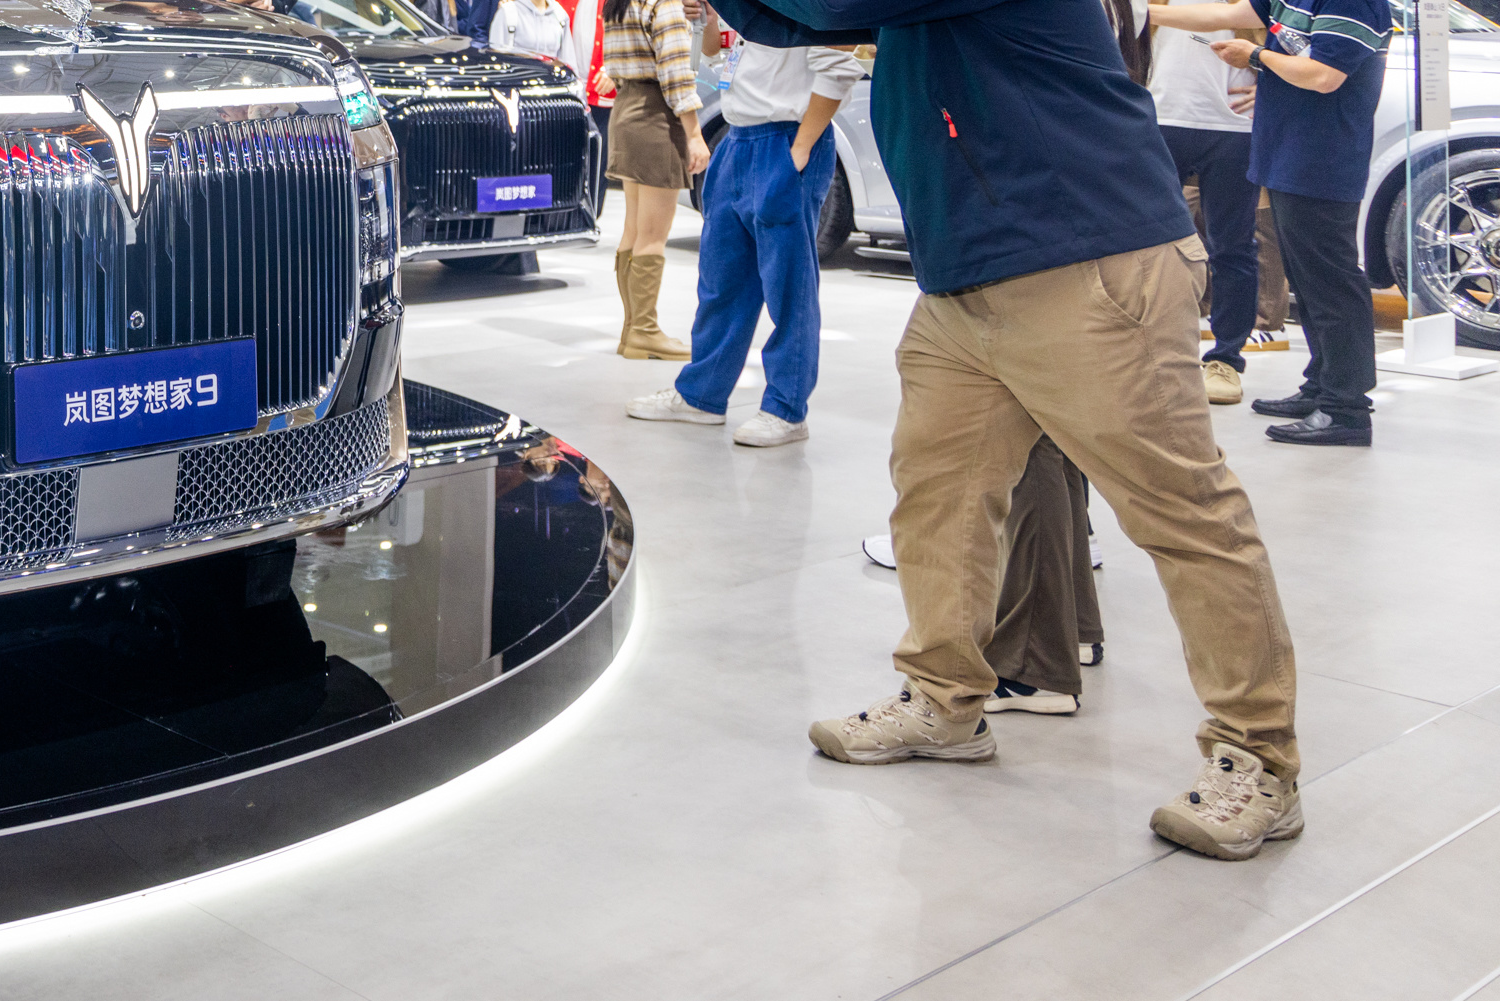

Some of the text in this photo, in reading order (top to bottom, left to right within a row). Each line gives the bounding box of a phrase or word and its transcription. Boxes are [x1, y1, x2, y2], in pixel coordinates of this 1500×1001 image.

[494, 185, 537, 201] 岚图梦想家
[63, 373, 219, 426] 岚图梦想家9
[1225, 751, 1244, 763] Jeep
